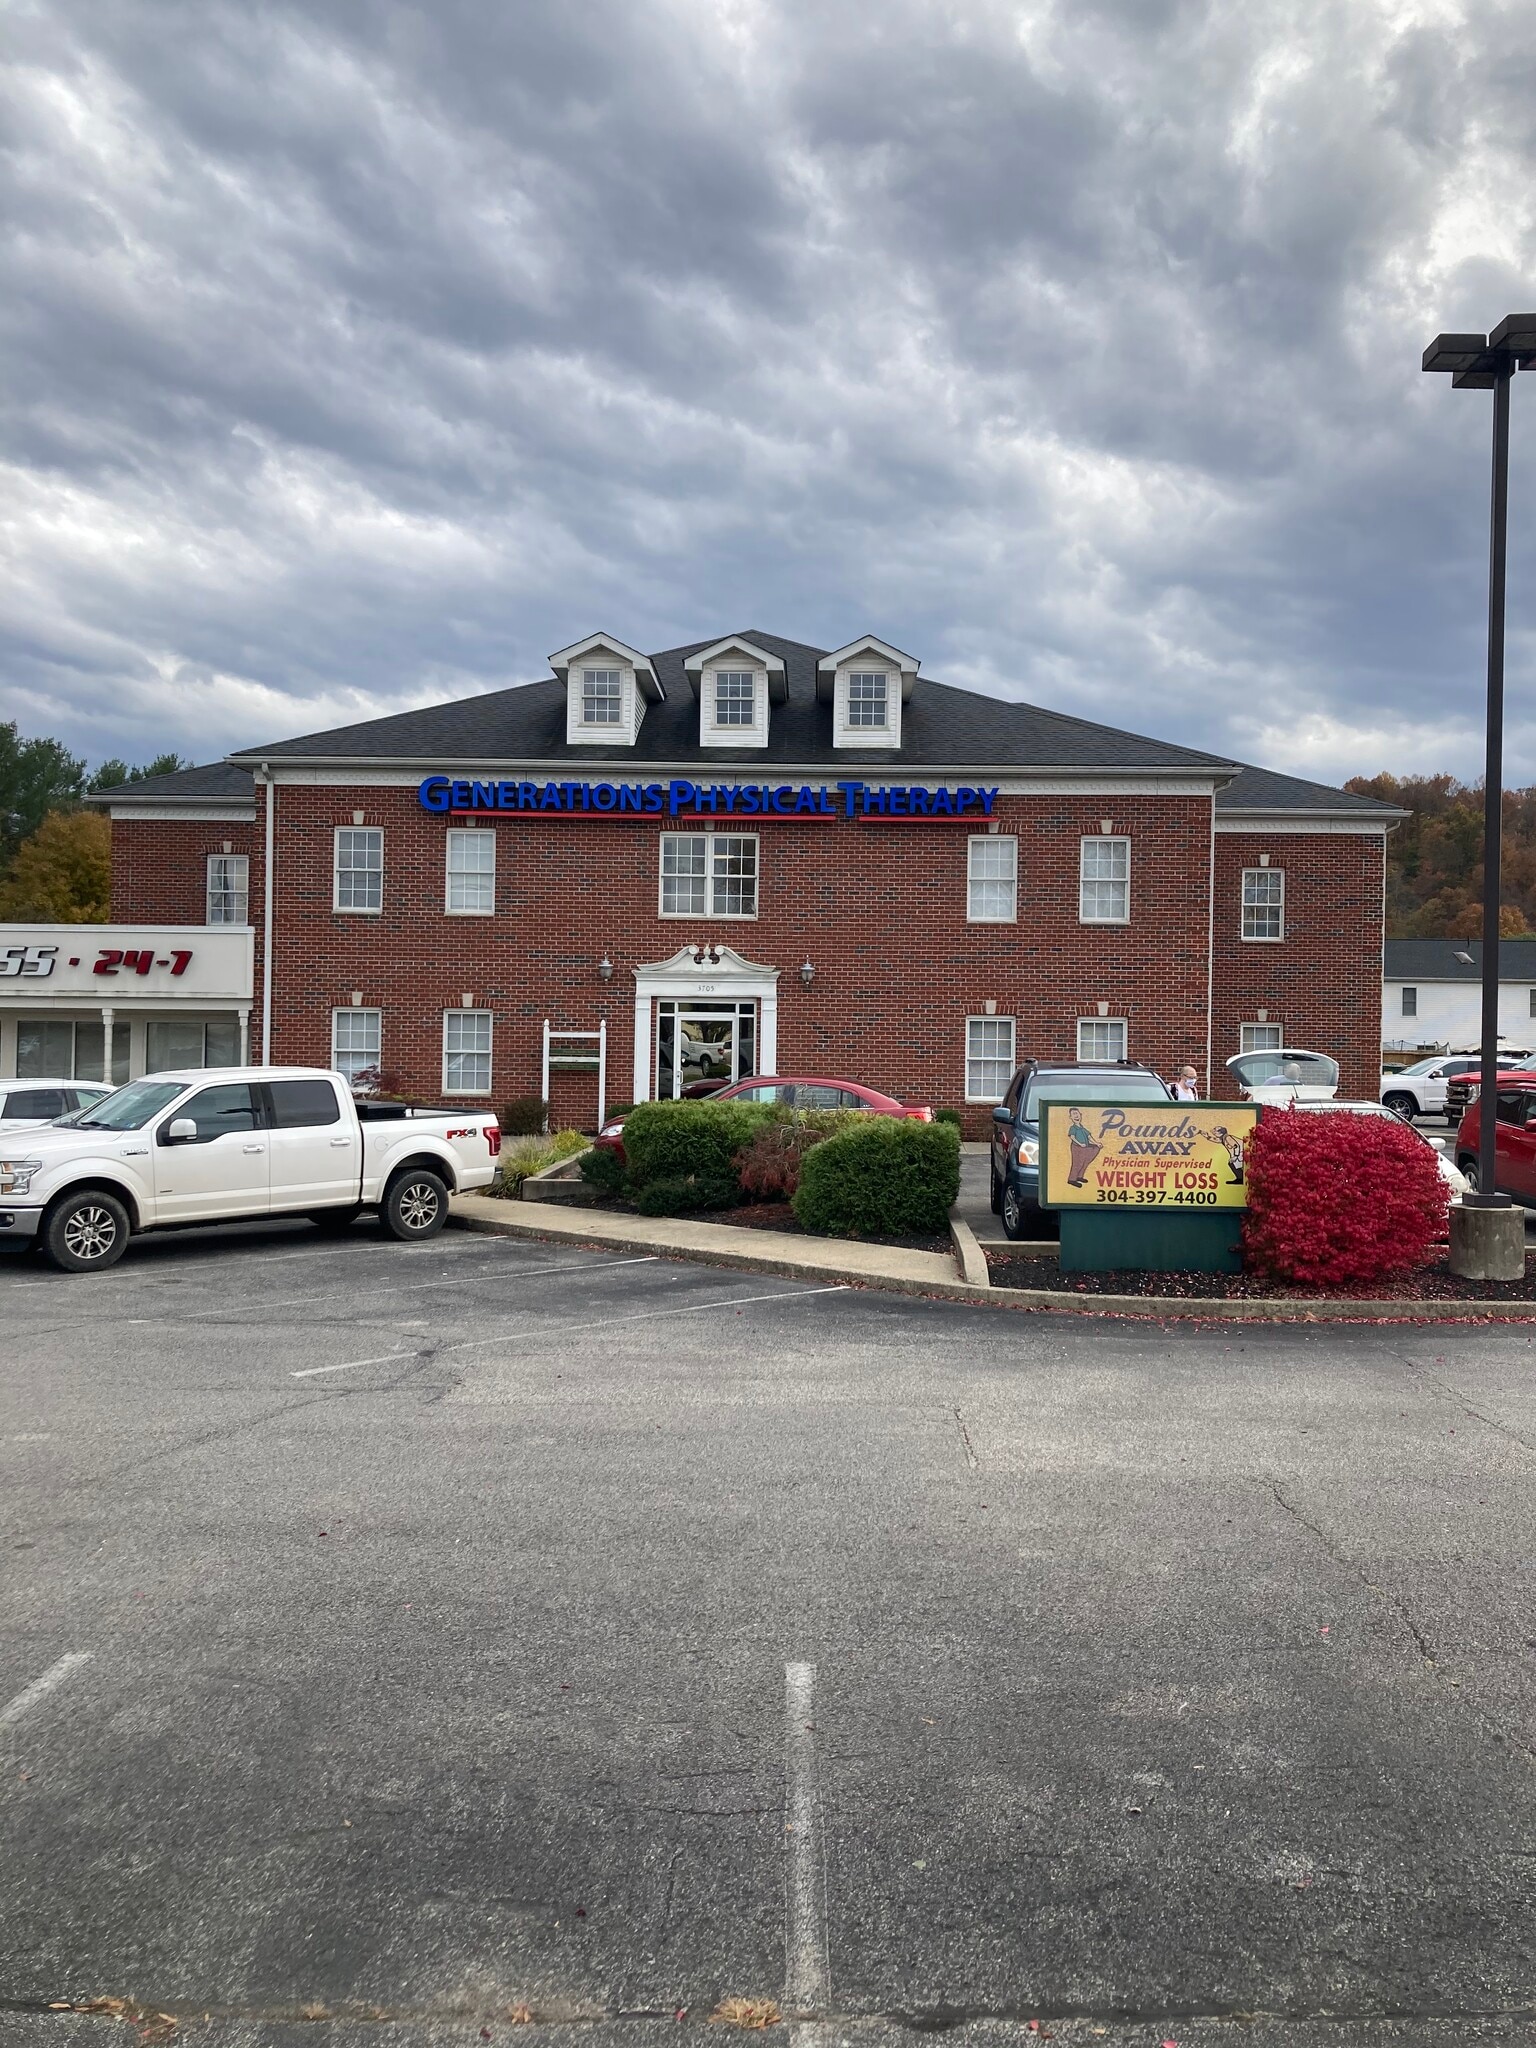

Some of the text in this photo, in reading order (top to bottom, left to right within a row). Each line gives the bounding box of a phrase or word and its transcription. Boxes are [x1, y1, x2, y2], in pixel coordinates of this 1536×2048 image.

[418, 776, 999, 818] GENERATIONS PHYSICAL THERAPY
[93, 950, 193, 975] 24-7
[1098, 1109, 1198, 1139] Pounds
[1118, 1141, 1197, 1156] AWAY
[1102, 1156, 1213, 1170] Physician Supervised
[1096, 1171, 1219, 1189] WEIGHT LOSS
[1096, 1190, 1218, 1204] 304-397-4400
